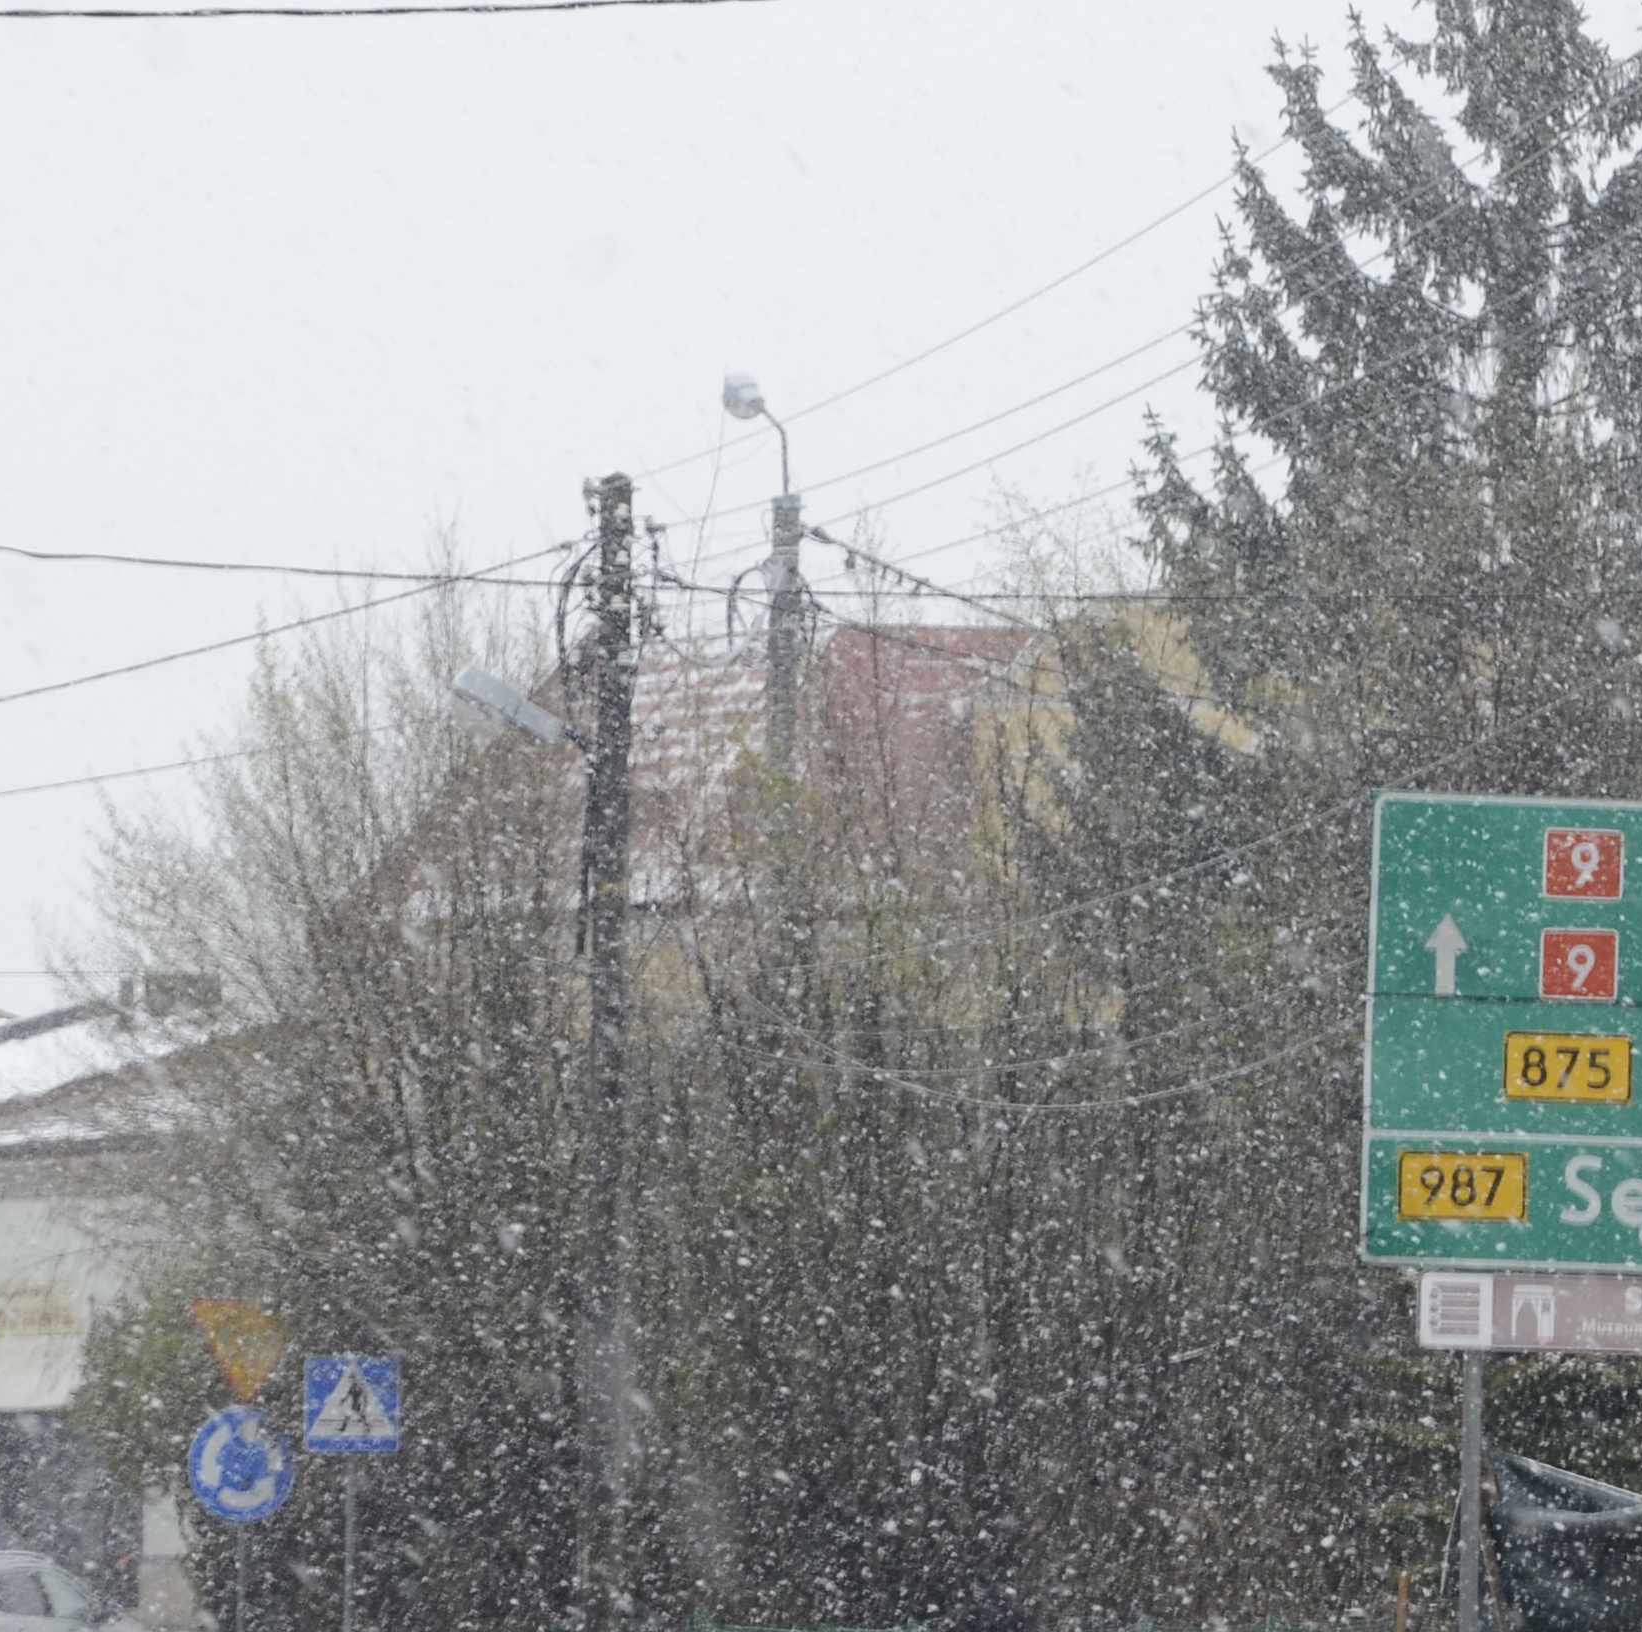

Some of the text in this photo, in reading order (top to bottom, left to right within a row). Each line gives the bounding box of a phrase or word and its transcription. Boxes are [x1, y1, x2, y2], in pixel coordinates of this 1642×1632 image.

[1570, 842, 1598, 884] 9
[1566, 944, 1595, 989] 9
[1520, 1049, 1612, 1090] 875
[1420, 1166, 1503, 1205] 987
